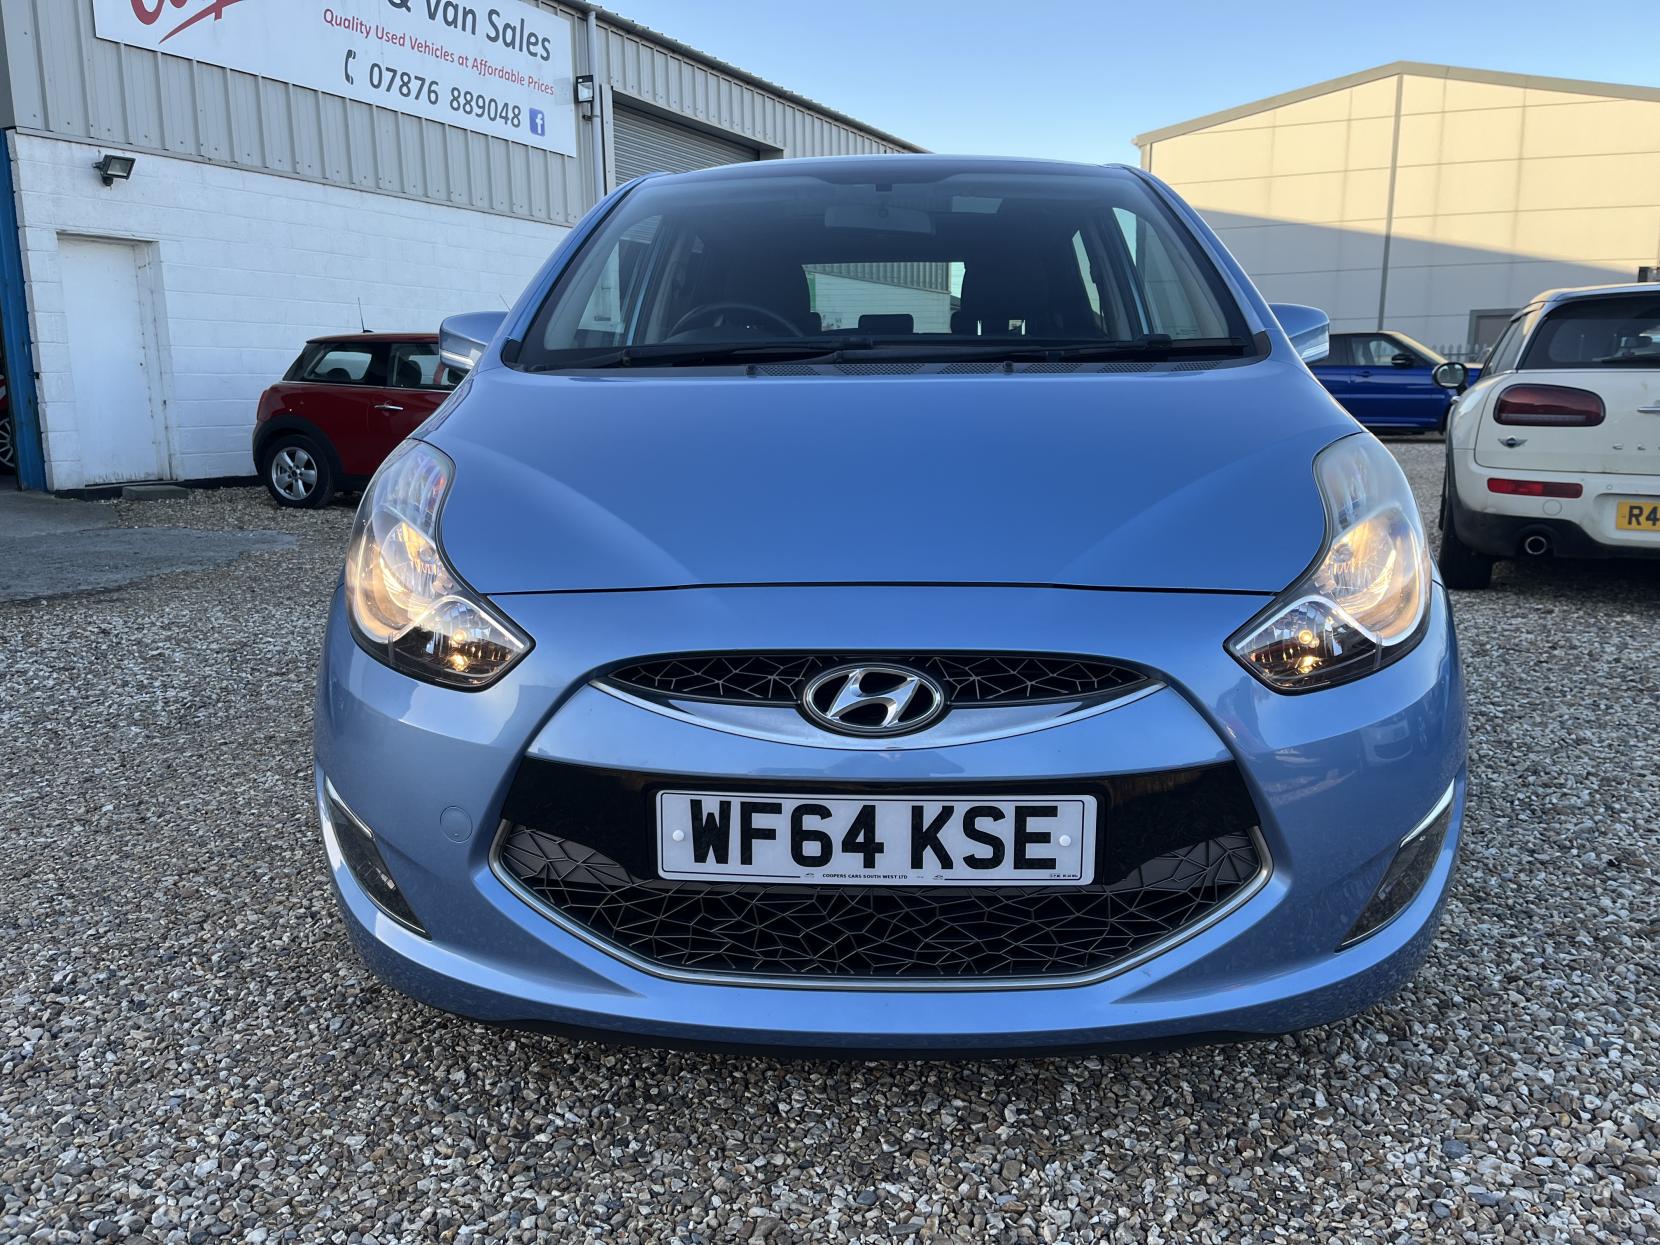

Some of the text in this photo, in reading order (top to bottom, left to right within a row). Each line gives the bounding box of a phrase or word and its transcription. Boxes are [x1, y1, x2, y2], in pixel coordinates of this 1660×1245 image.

[323, 8, 554, 95] Quality Used Vehicles at Affordable Prices
[426, 0, 551, 62] Van Sales
[369, 62, 521, 128] 07876 889048
[1628, 505, 1660, 526] R4
[689, 798, 1059, 871] WF64 KSE
